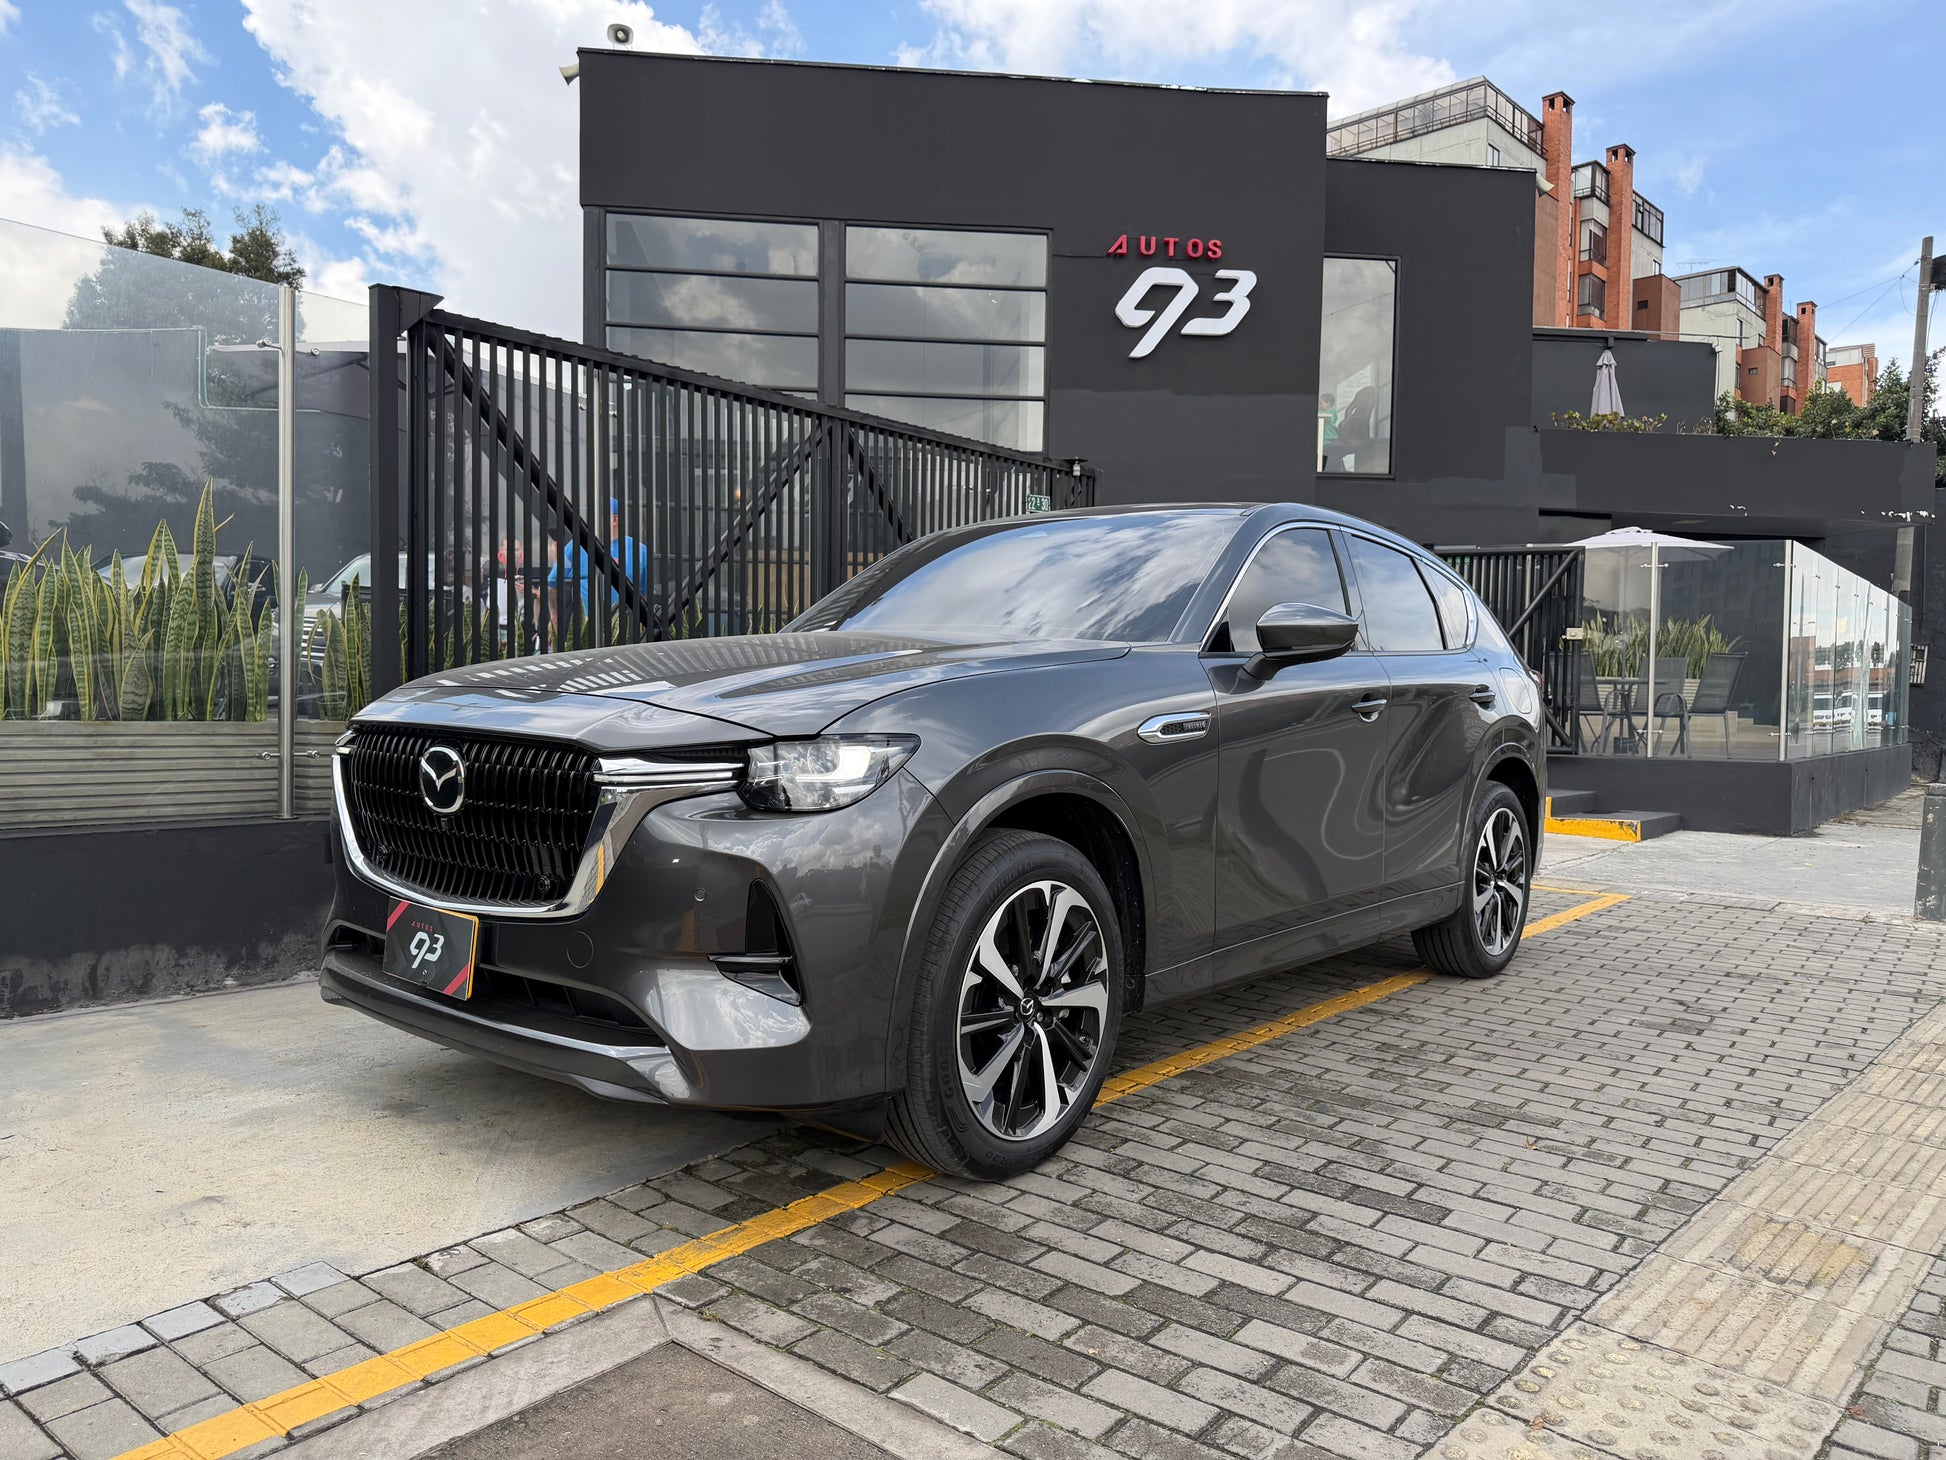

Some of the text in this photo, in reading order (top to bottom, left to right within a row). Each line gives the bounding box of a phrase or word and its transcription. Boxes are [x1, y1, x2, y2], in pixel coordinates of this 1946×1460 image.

[1107, 235, 1223, 260] AUTOS
[1115, 267, 1257, 358] 93
[409, 931, 445, 969] 93
